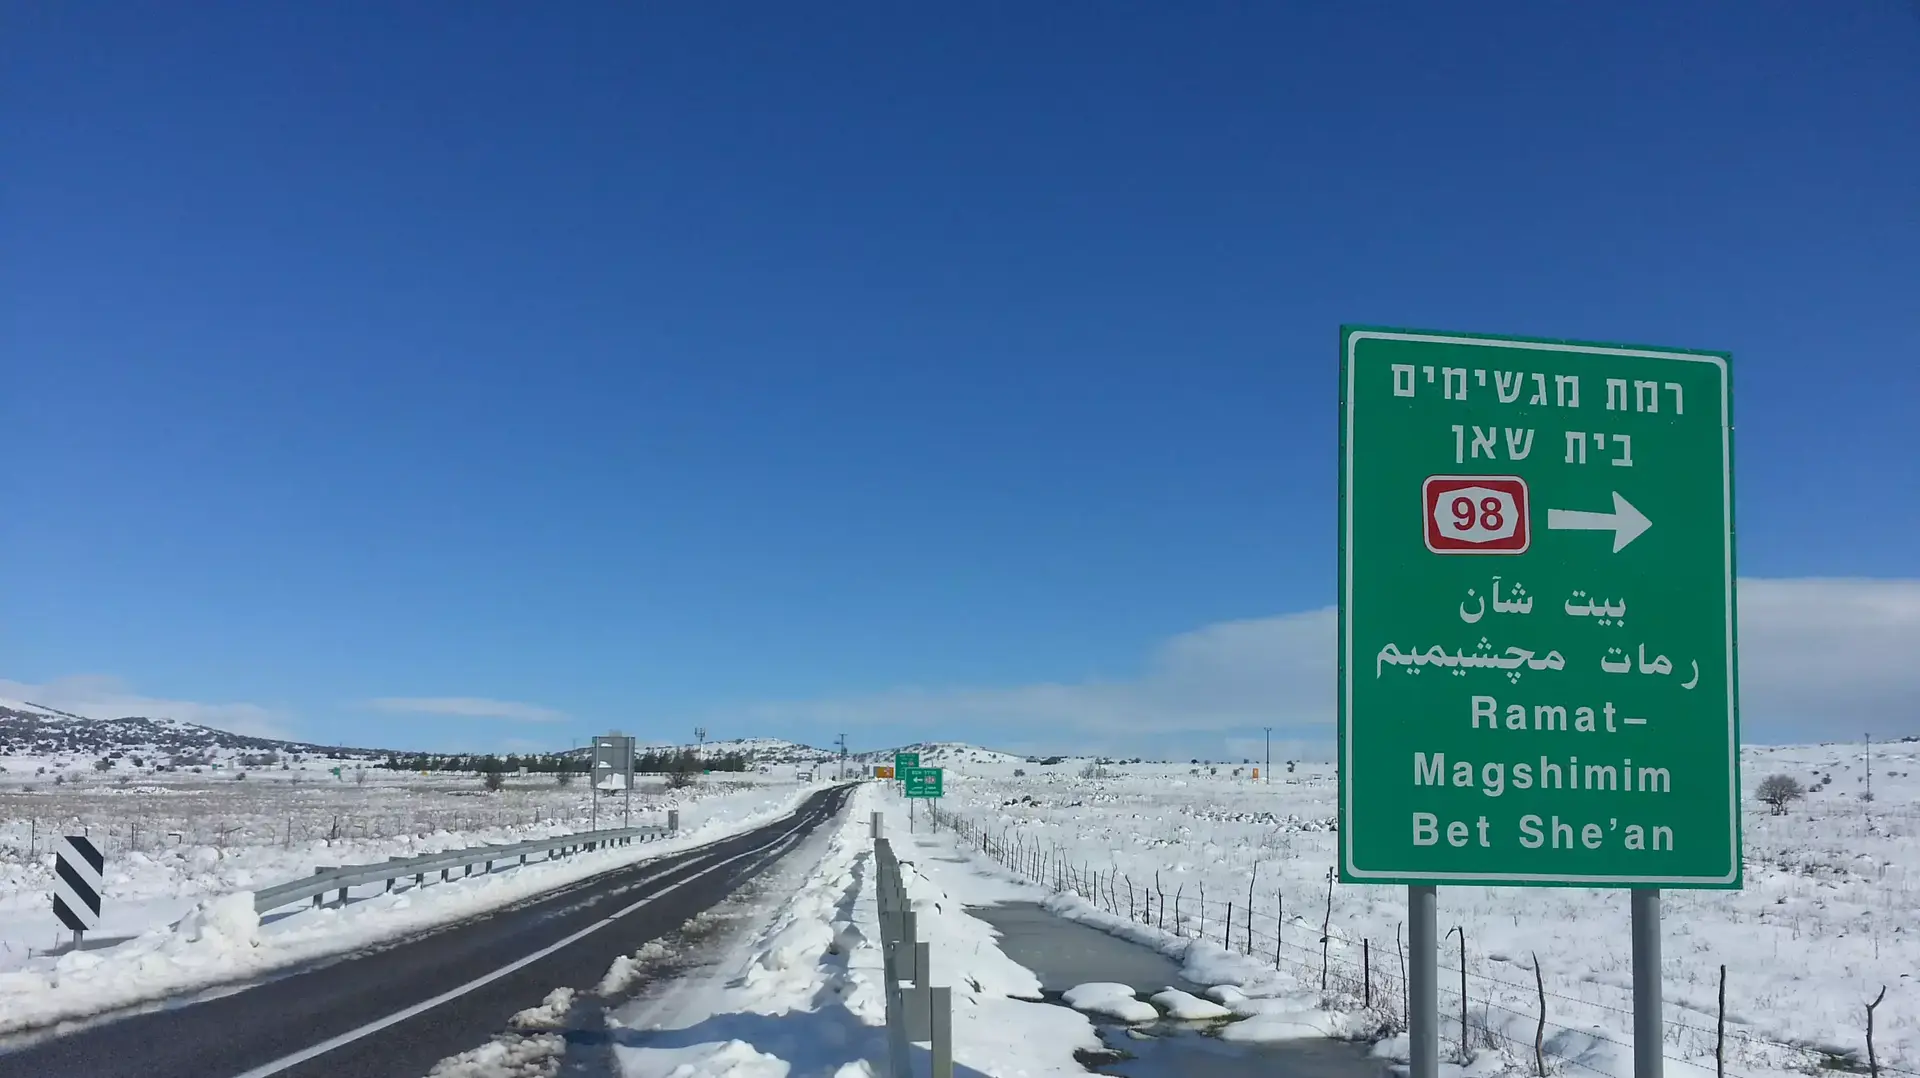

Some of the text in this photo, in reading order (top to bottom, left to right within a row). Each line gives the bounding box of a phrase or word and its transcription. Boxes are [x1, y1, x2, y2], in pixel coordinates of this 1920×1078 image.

[1391, 364, 1683, 414] רמת מגשימים
[1451, 425, 1633, 467] בית שאן
[1451, 496, 1504, 531] 98
[1459, 576, 1627, 627] بيت شآن
[1602, 643, 1699, 689] رمات
[1414, 753, 1671, 797] Magshimim
[1412, 812, 1674, 851] Bet She'an
